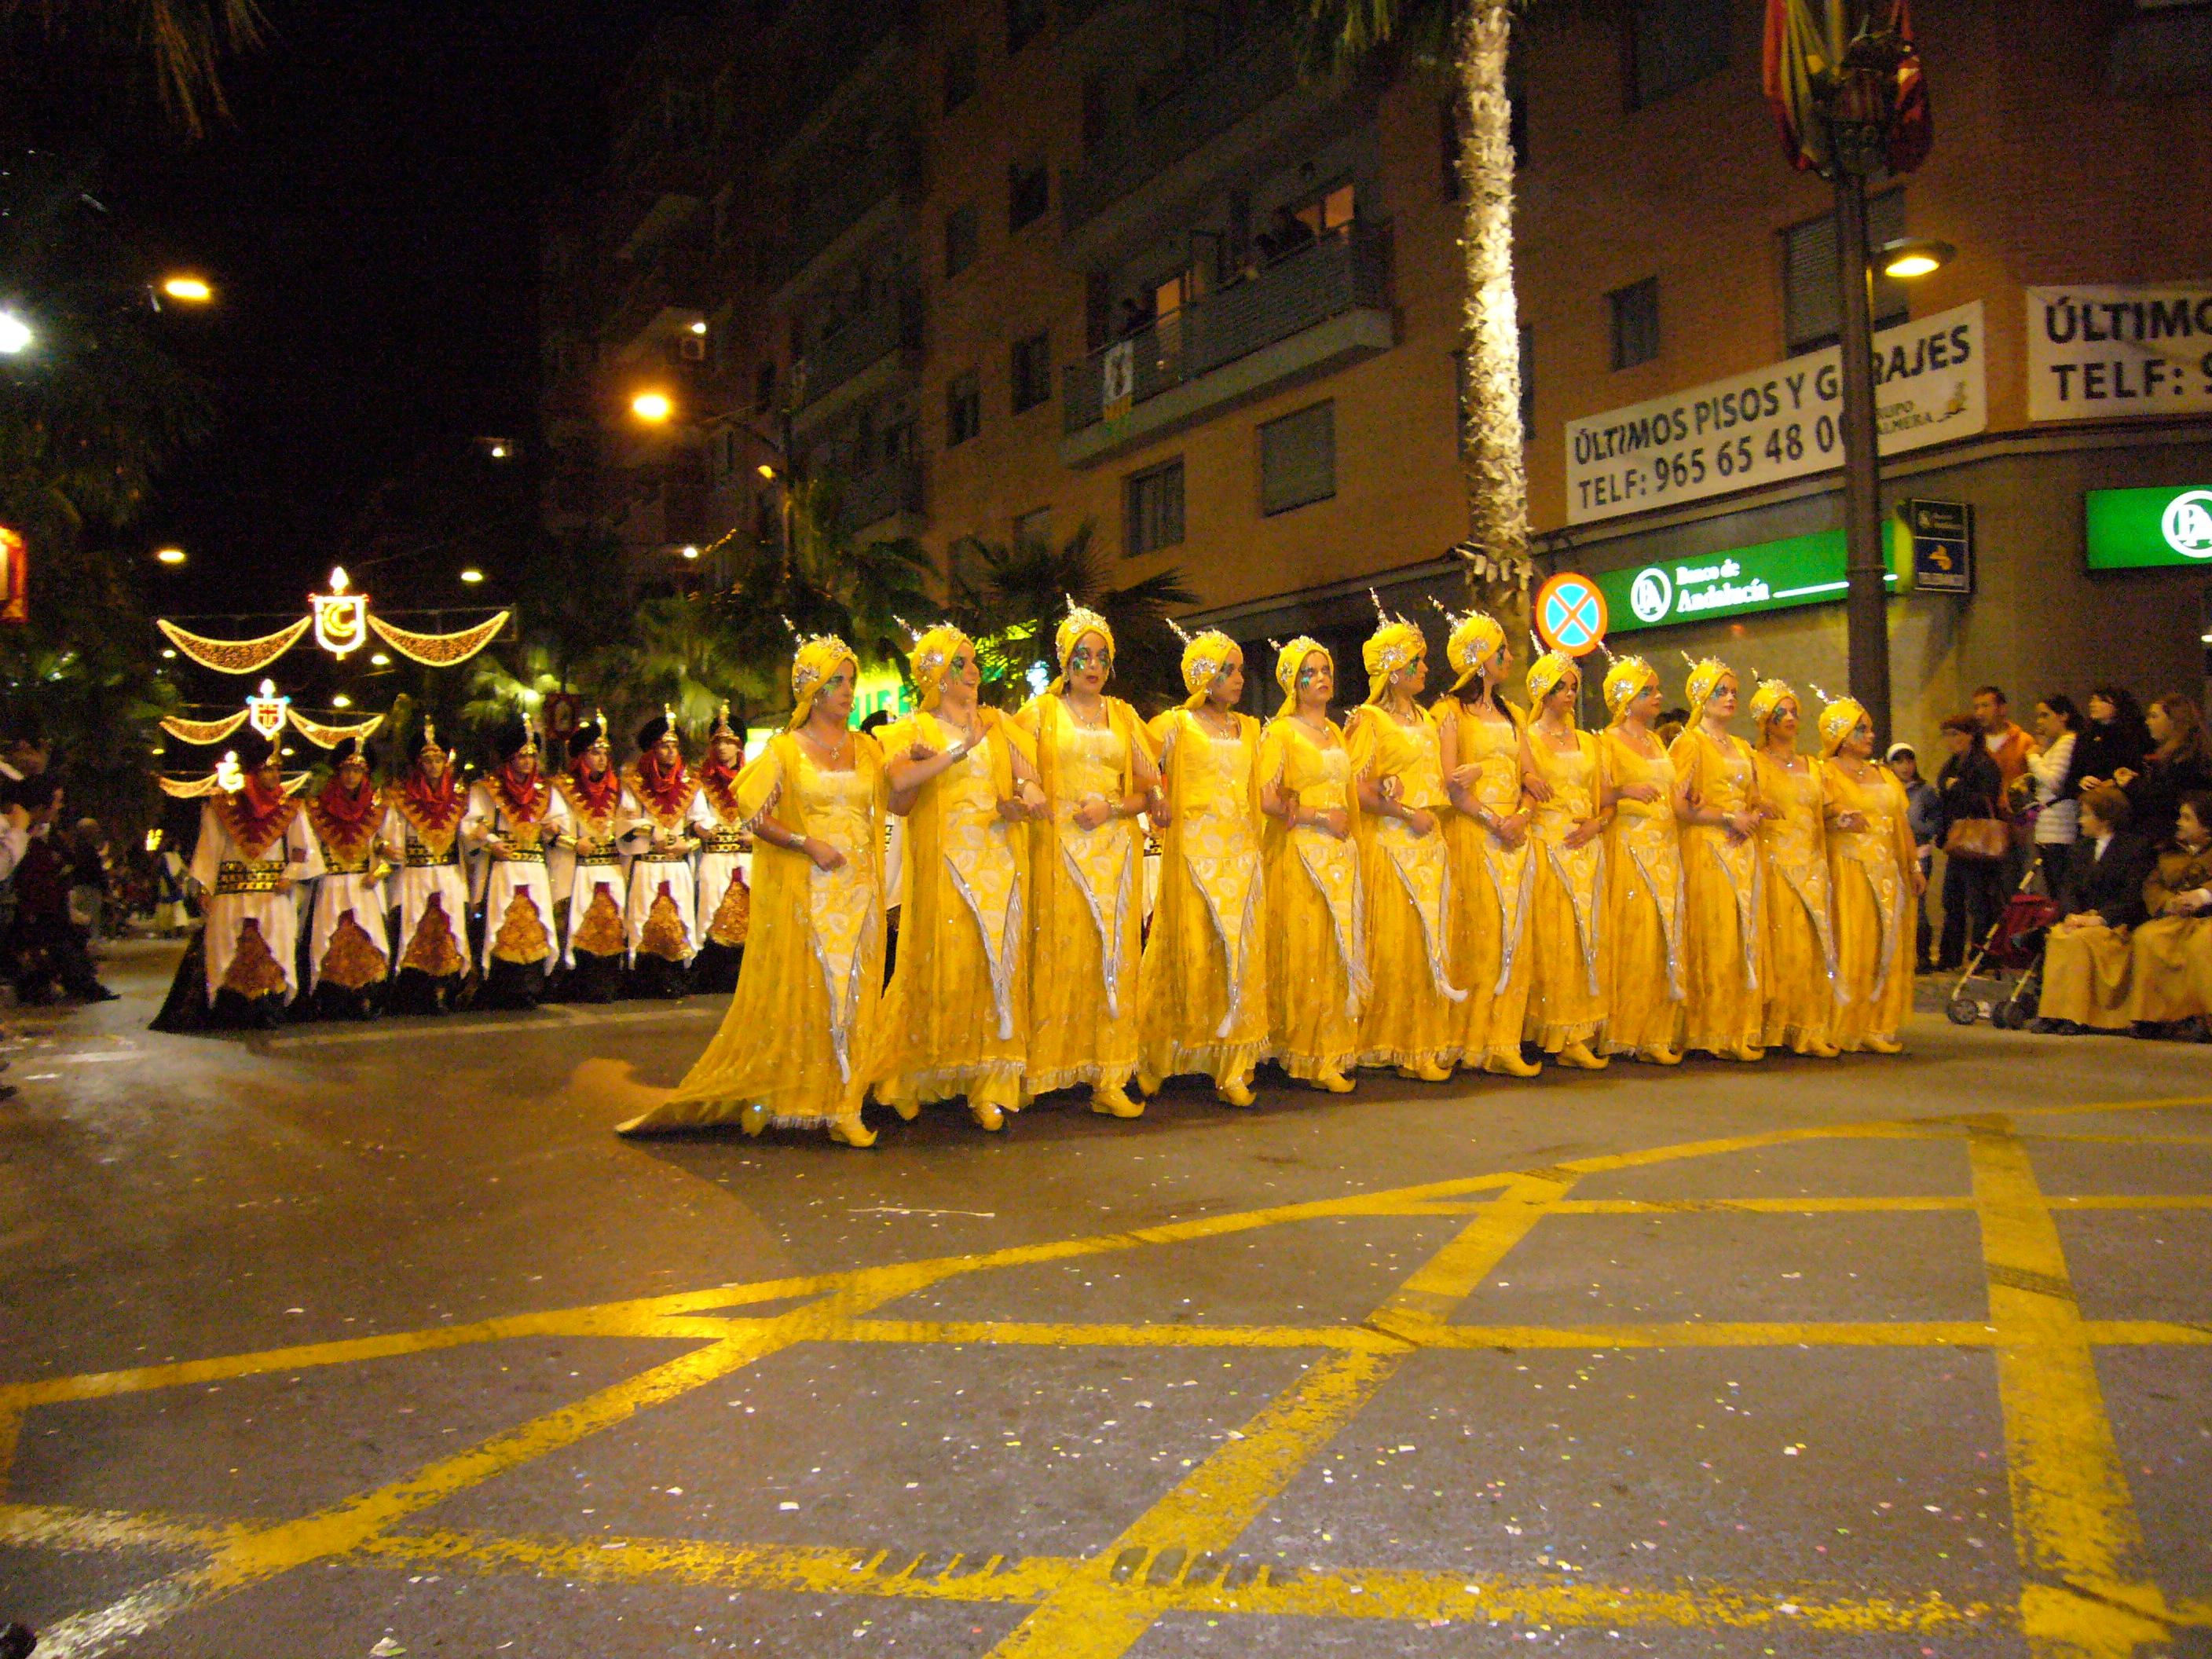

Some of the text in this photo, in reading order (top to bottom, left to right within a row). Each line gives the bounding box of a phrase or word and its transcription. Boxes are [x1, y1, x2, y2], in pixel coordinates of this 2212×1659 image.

[1574, 324, 1971, 465] ÚLTIMOS PISOS Y GRAJES
[2050, 358, 2184, 401] TELF:
[1578, 468, 1647, 509] TELF:
[1654, 448, 1705, 493] 965
[1716, 435, 1752, 476] 65
[1765, 423, 1804, 463] 48
[1675, 558, 1741, 585] Banco de
[1675, 577, 1770, 613] Andalucía
